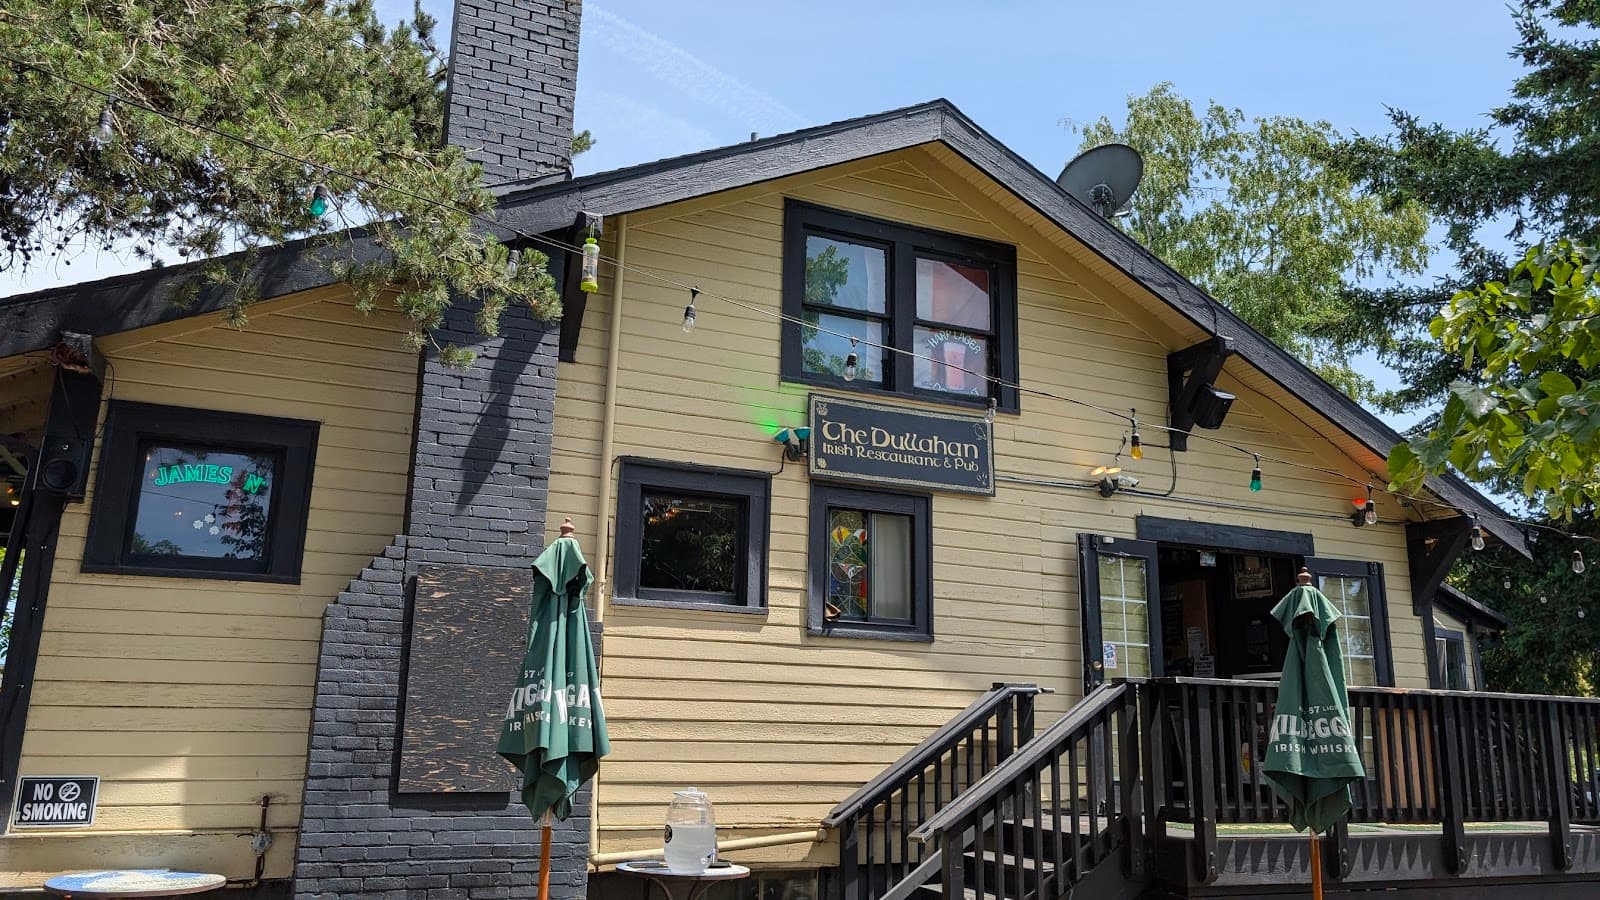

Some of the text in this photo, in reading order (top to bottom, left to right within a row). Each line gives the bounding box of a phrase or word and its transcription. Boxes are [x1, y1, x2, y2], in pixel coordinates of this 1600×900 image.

[953, 331, 981, 354] LAGER
[821, 419, 979, 460] The Dullahan
[855, 445, 942, 468] Restaurant
[943, 457, 952, 469] &
[954, 458, 980, 473] Pub
[1275, 743, 1306, 754] IRISH
[33, 782, 54, 801] NO
[21, 802, 87, 821] SMOKING
